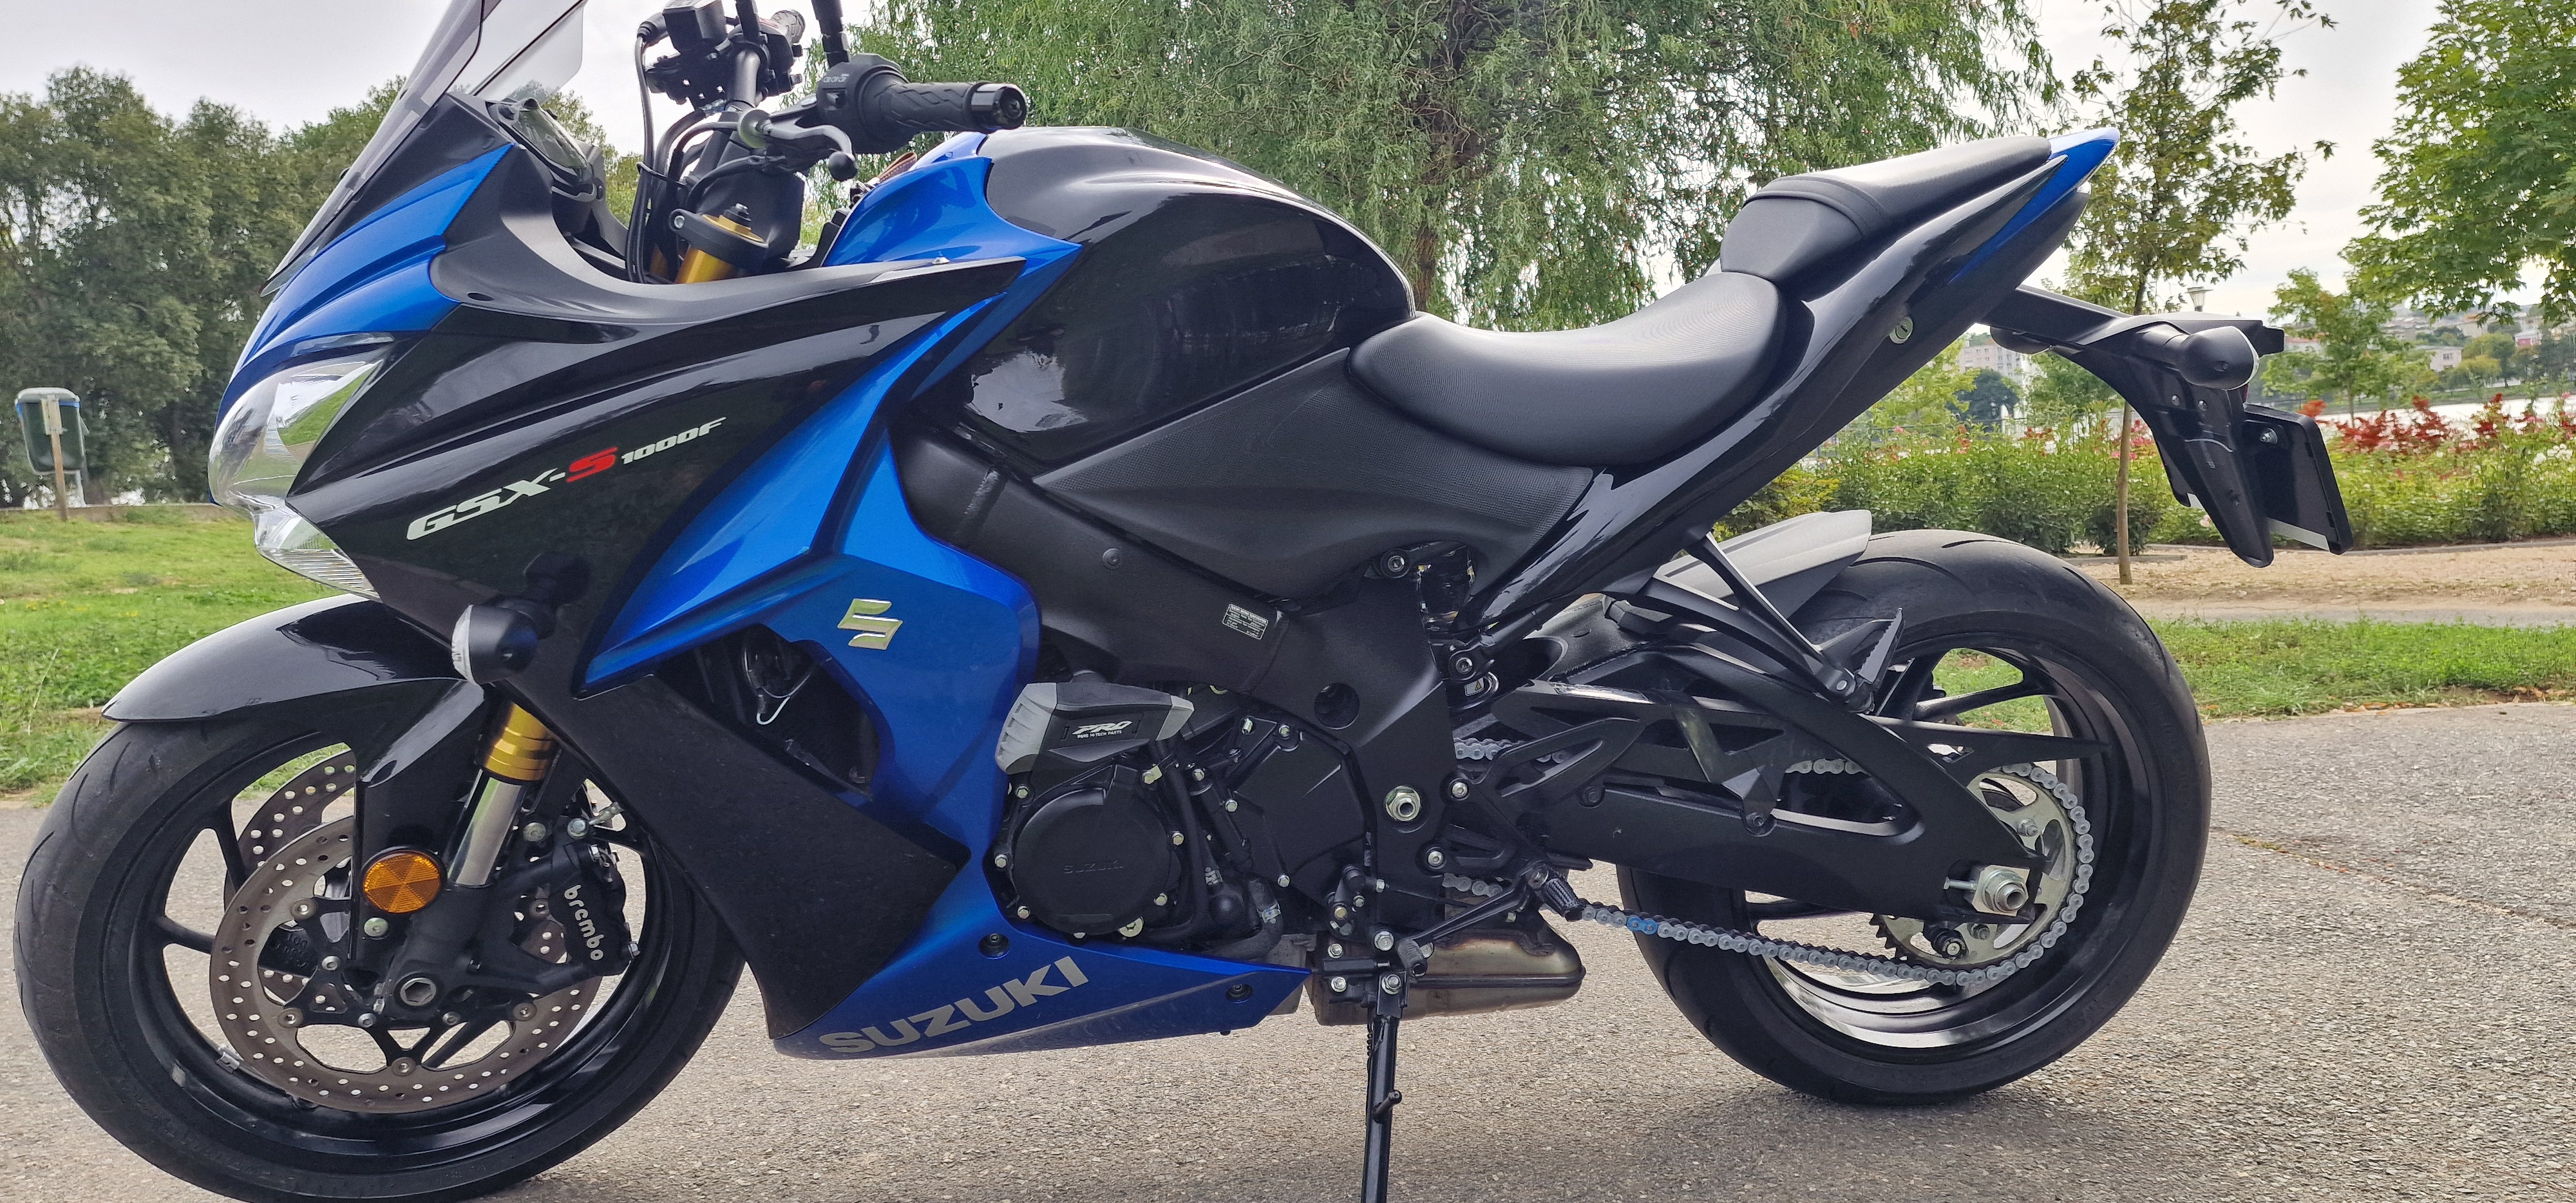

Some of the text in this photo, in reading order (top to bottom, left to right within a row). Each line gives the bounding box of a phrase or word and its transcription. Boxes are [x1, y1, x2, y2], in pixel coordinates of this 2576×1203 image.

[1072, 721, 1133, 735] PRO
[564, 884, 605, 960] brembo
[819, 956, 1089, 1053] SUZUKI
